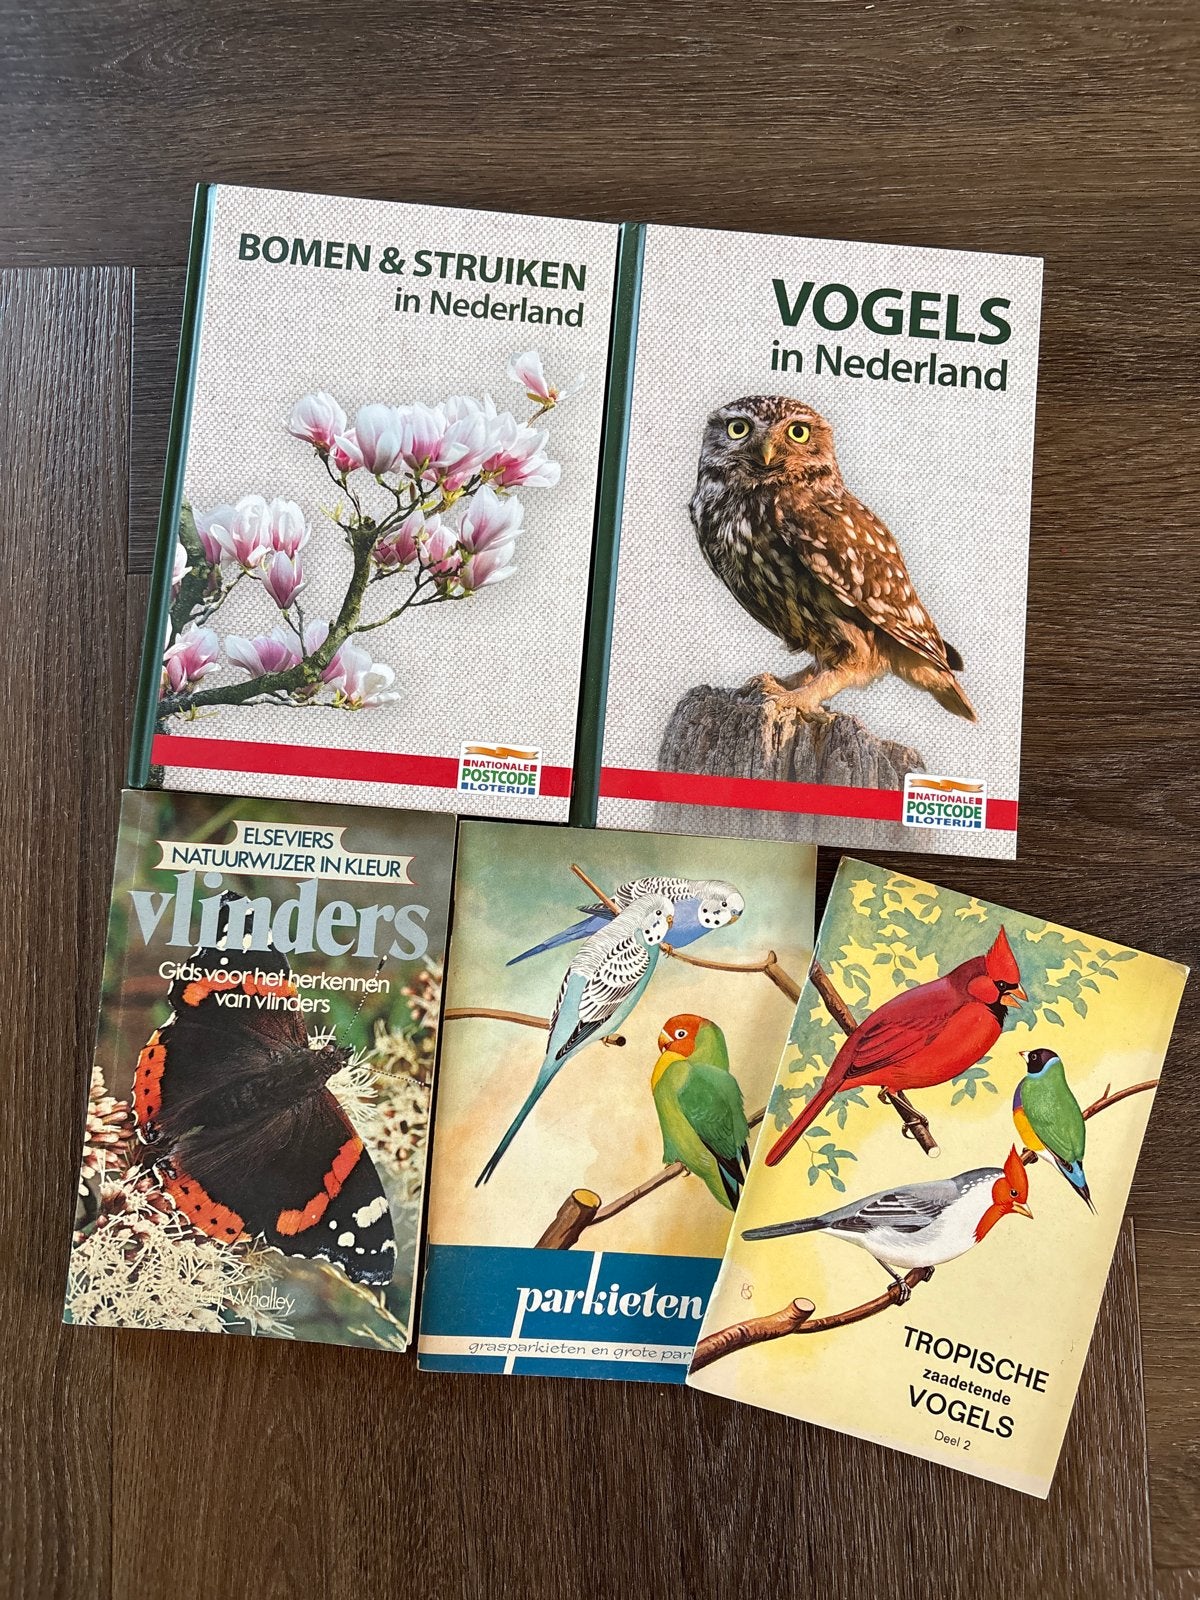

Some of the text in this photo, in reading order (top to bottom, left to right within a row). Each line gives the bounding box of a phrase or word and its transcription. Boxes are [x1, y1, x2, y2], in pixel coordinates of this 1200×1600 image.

[238, 233, 587, 291] BOMEN & STRUIKEN
[394, 287, 585, 328] in Nederland
[771, 278, 1012, 345] VOGELS
[771, 339, 1008, 391] in Nederland
[462, 768, 537, 786] POSTCODE
[471, 760, 529, 772] NATIONALE
[470, 783, 527, 794] LOTERIJ
[916, 792, 974, 805] NATIONALE
[907, 801, 982, 819] POSTCODE
[915, 816, 973, 828] LOTERIJ
[243, 827, 334, 849] ELSEVIERS
[172, 847, 401, 878] NATUURWIJZER IN KLEUR
[127, 869, 431, 961] vlinders
[158, 961, 390, 994] Gids voor het herkennen
[215, 991, 331, 1014] van vlinders
[229, 1285, 295, 1316] Whalley
[512, 1282, 704, 1321] parkieten
[468, 1340, 586, 1356] grasparkieten
[591, 1347, 609, 1356] en
[613, 1346, 657, 1361] grote
[904, 1325, 1049, 1393] TROPISCHE
[922, 1367, 1011, 1405] zaadetende
[909, 1384, 1014, 1438] VOGELS
[934, 1429, 971, 1451] Deel 2
